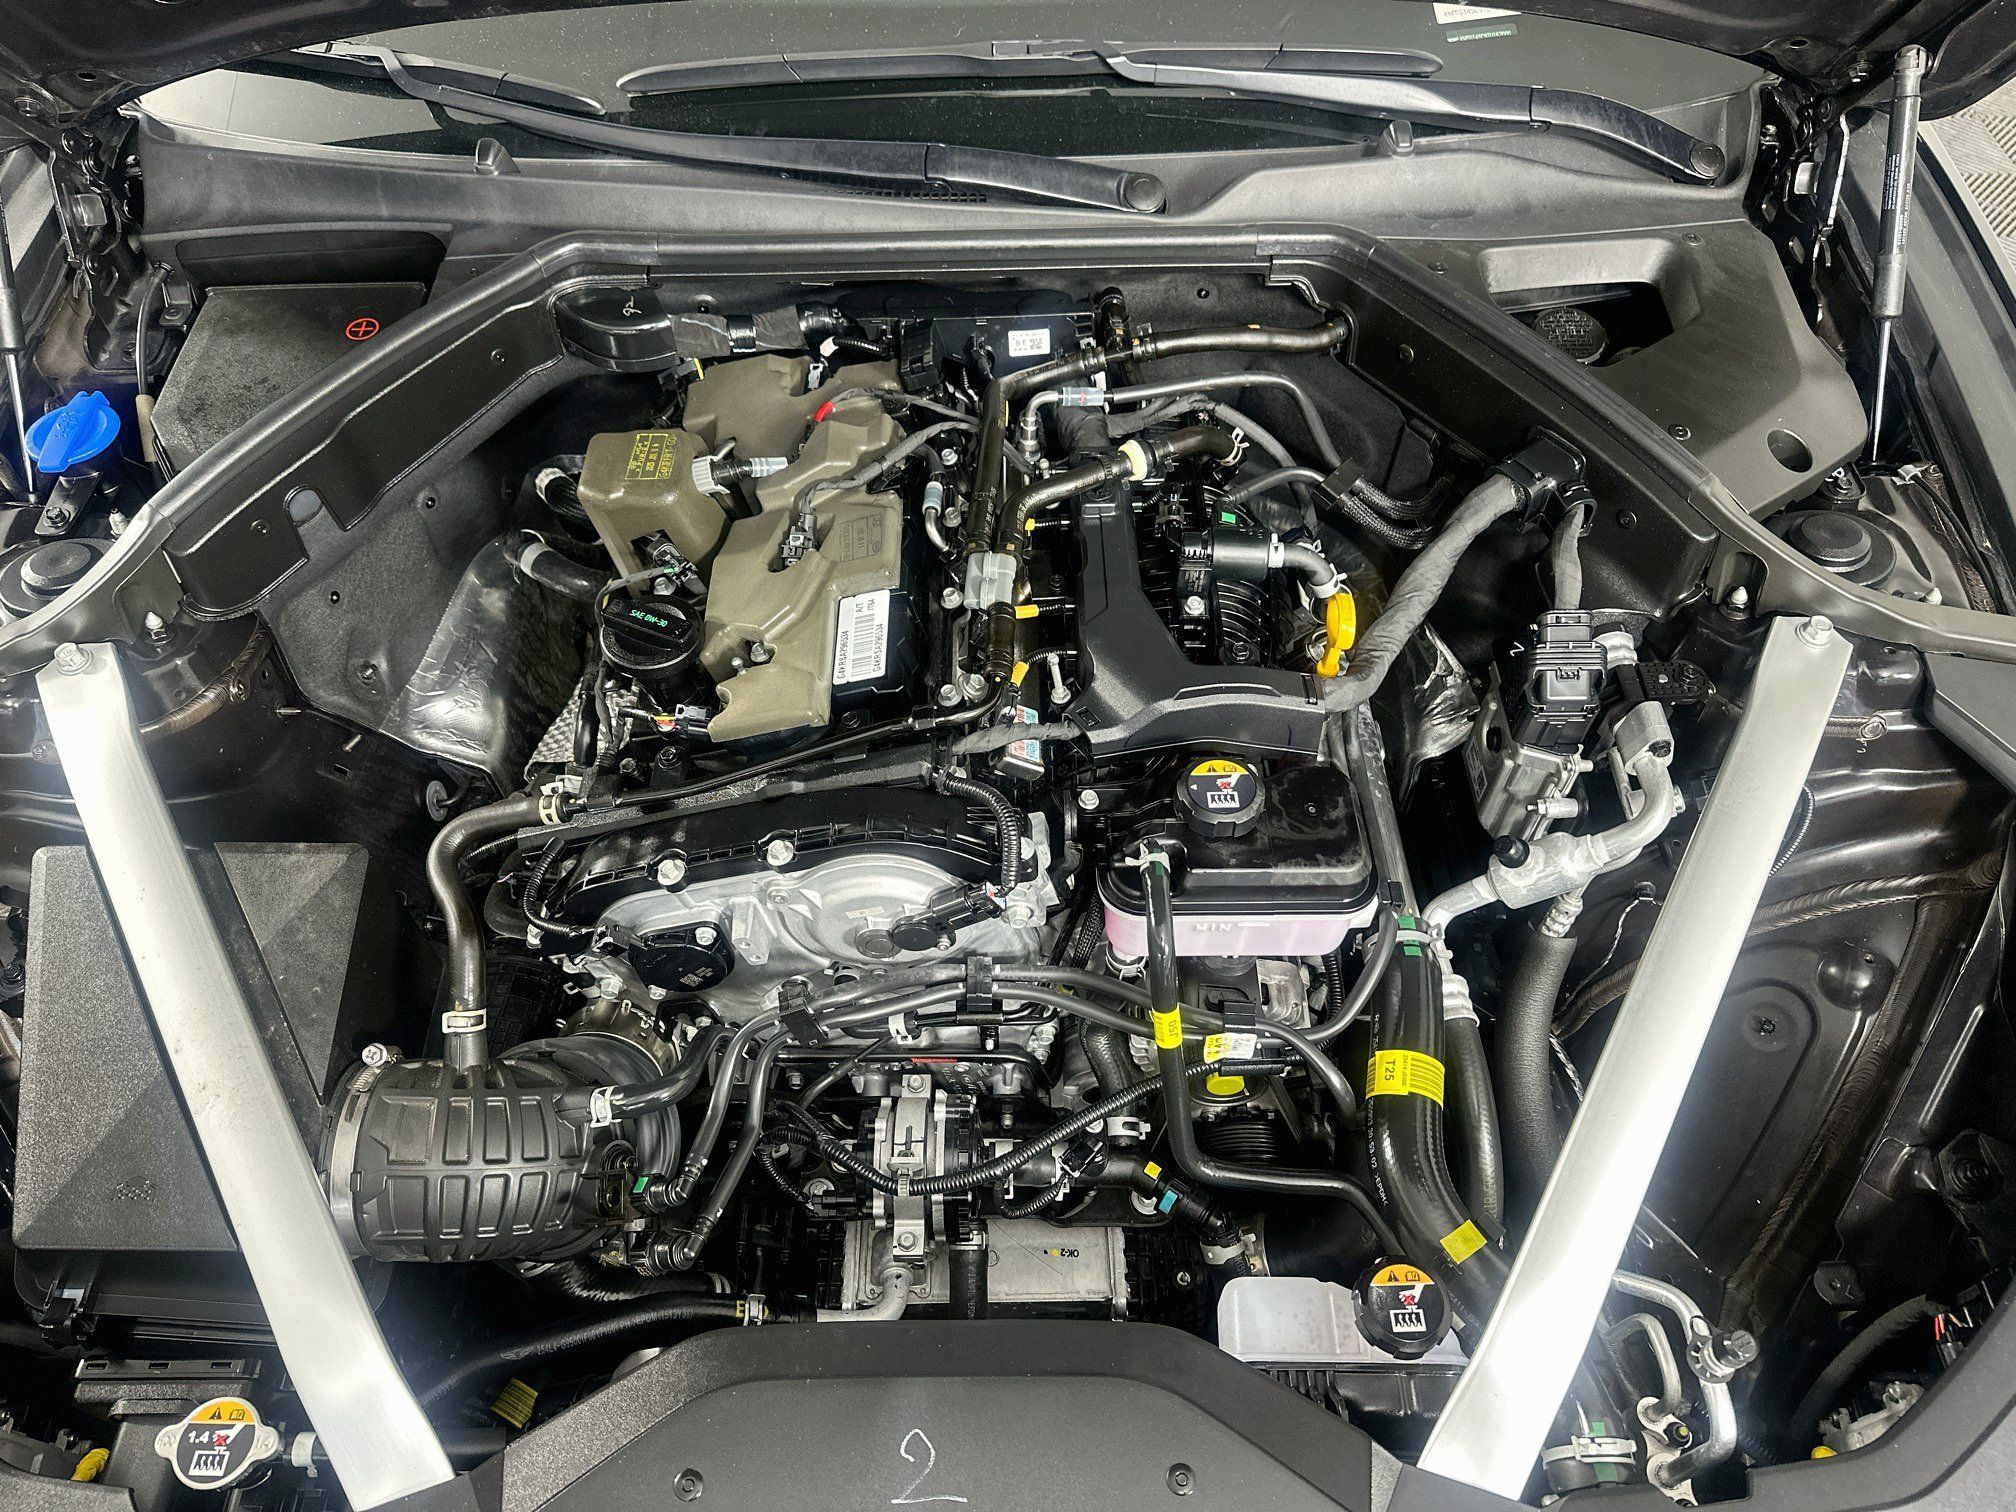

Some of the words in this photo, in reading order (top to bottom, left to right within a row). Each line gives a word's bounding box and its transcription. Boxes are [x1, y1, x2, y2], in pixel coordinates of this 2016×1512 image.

[629, 609, 646, 620] SAE
[644, 613, 669, 628] 0W-30
[1194, 922, 1232, 933] MIN
[1168, 1019, 1179, 1038] J50
[1384, 1058, 1396, 1081] T25
[1060, 1248, 1080, 1258] OK-2
[188, 1430, 210, 1444] 1.4
[890, 1428, 968, 1504] 2
